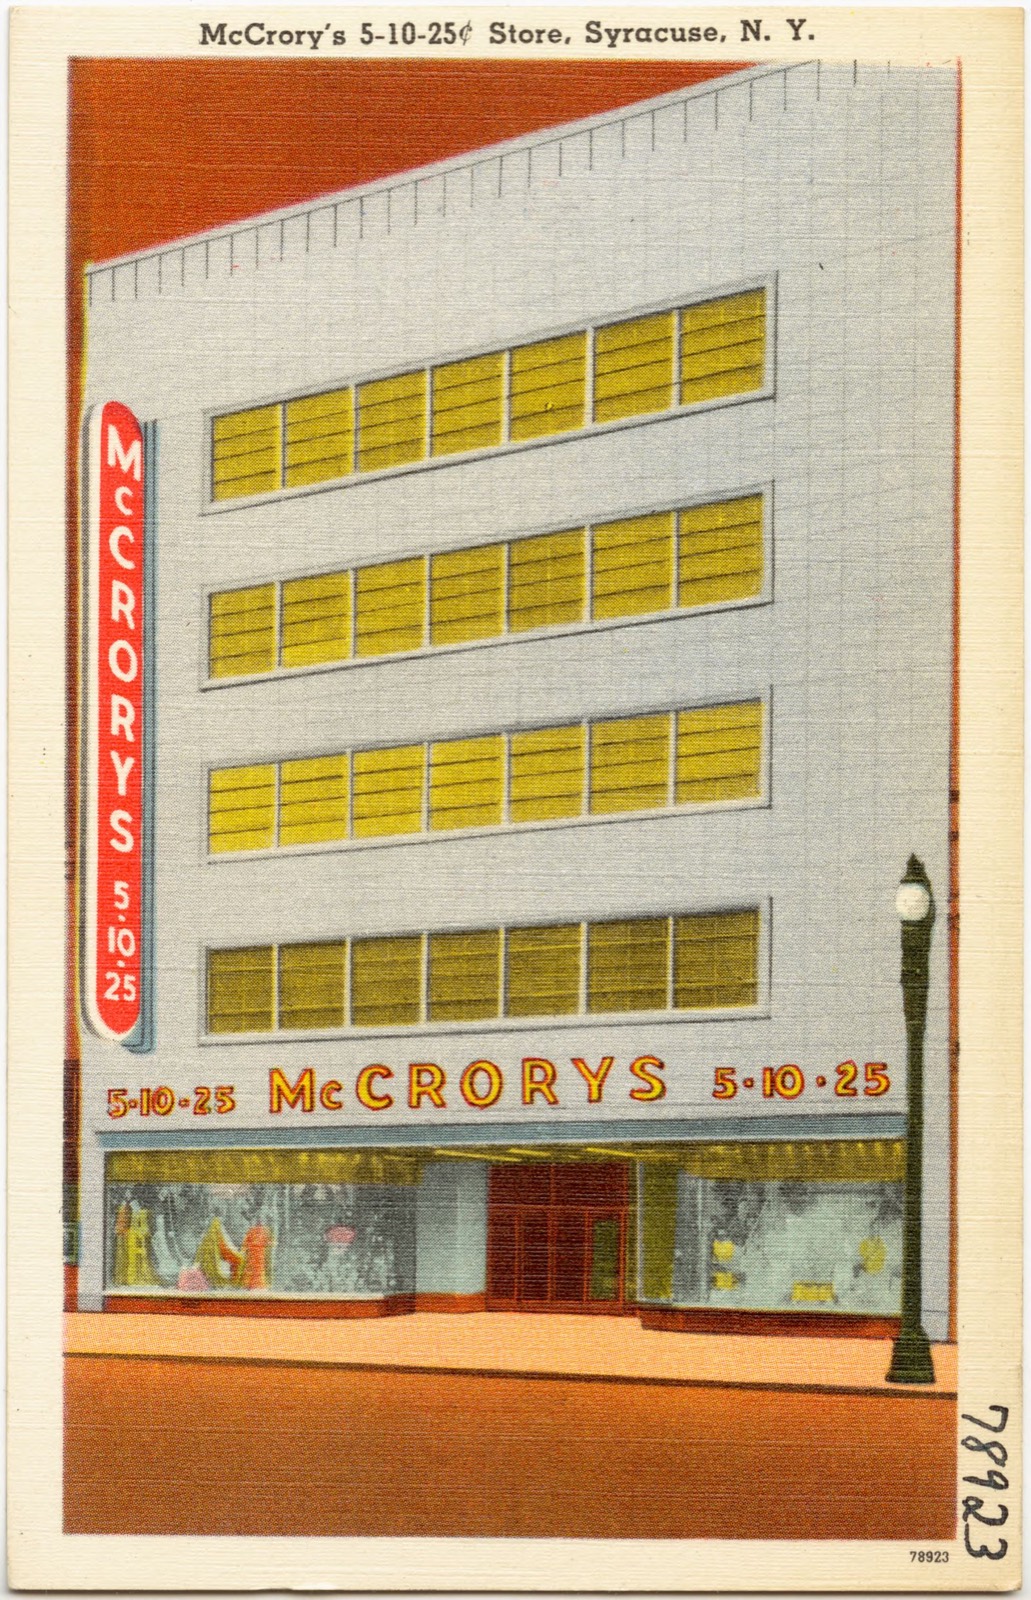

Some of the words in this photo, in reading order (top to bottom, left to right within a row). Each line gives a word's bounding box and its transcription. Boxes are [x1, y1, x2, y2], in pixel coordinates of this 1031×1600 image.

[200, 23, 345, 49] McCrory's
[361, 22, 472, 45] 5-10-25¢
[490, 22, 570, 44] Store,
[586, 21, 726, 48] Syracuse,
[741, 20, 770, 41] N.
[786, 19, 814, 40] Y.
[270, 1055, 666, 1113] McCRORYS
[961, 1405, 1009, 1560] 78923
[910, 1551, 949, 1562] 78923
